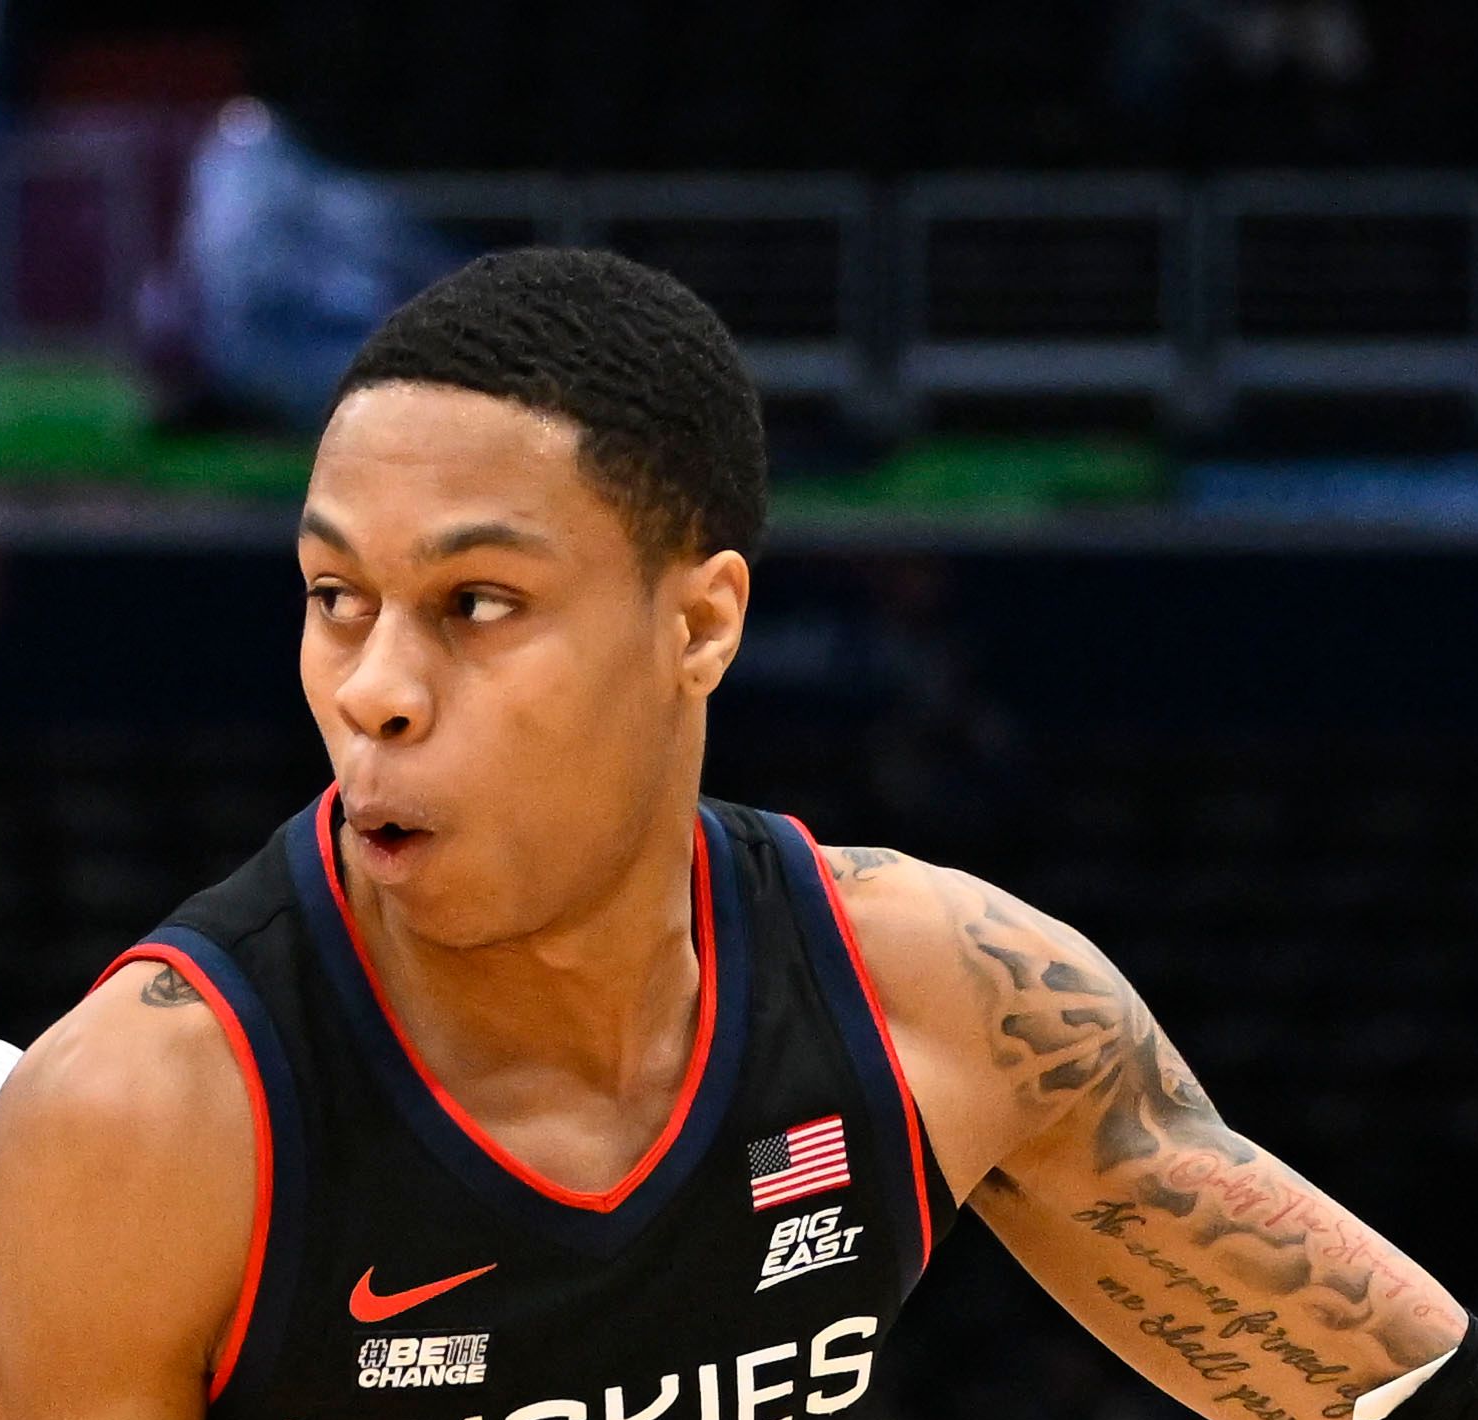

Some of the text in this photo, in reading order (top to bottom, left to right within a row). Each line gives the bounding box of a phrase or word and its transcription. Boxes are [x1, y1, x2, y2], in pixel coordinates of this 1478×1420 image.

[760, 1225, 865, 1277] EAST
[768, 1205, 843, 1251] BIG
[1139, 1313, 1252, 1382] shall
[357, 1363, 488, 1389] CHANGE
